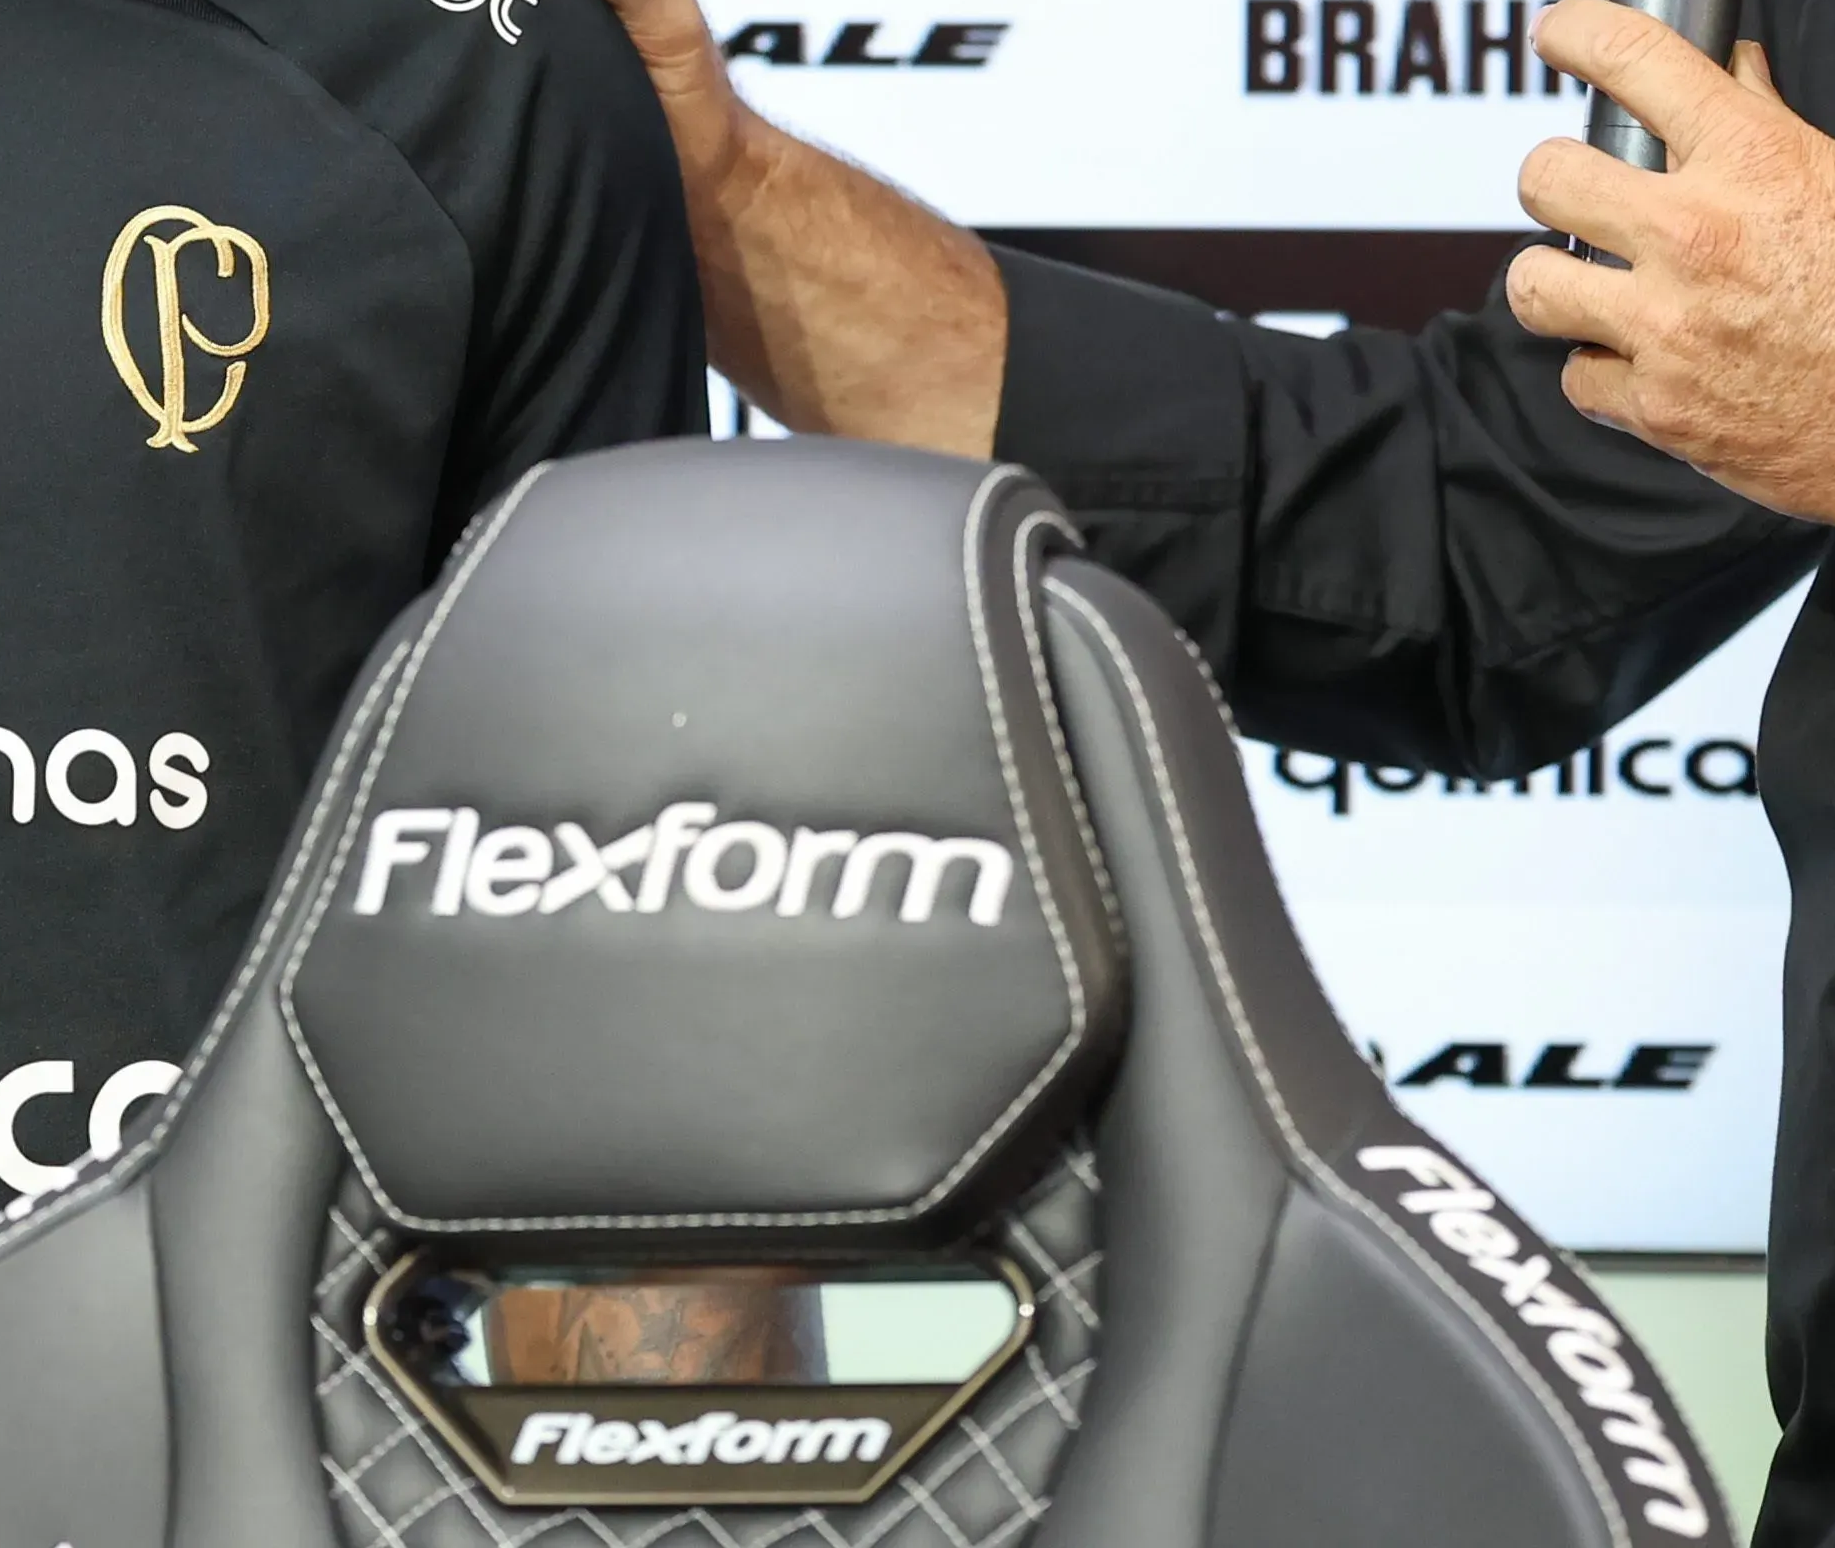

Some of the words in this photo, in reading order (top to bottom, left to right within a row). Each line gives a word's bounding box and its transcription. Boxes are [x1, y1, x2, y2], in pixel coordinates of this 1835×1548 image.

[723, 22, 1011, 65] ALE
[354, 802, 1012, 925] Flexform
[1393, 1042, 1717, 1089] ALE
[1357, 1142, 1710, 1540] Flexform
[511, 1412, 891, 1465] Flexform
